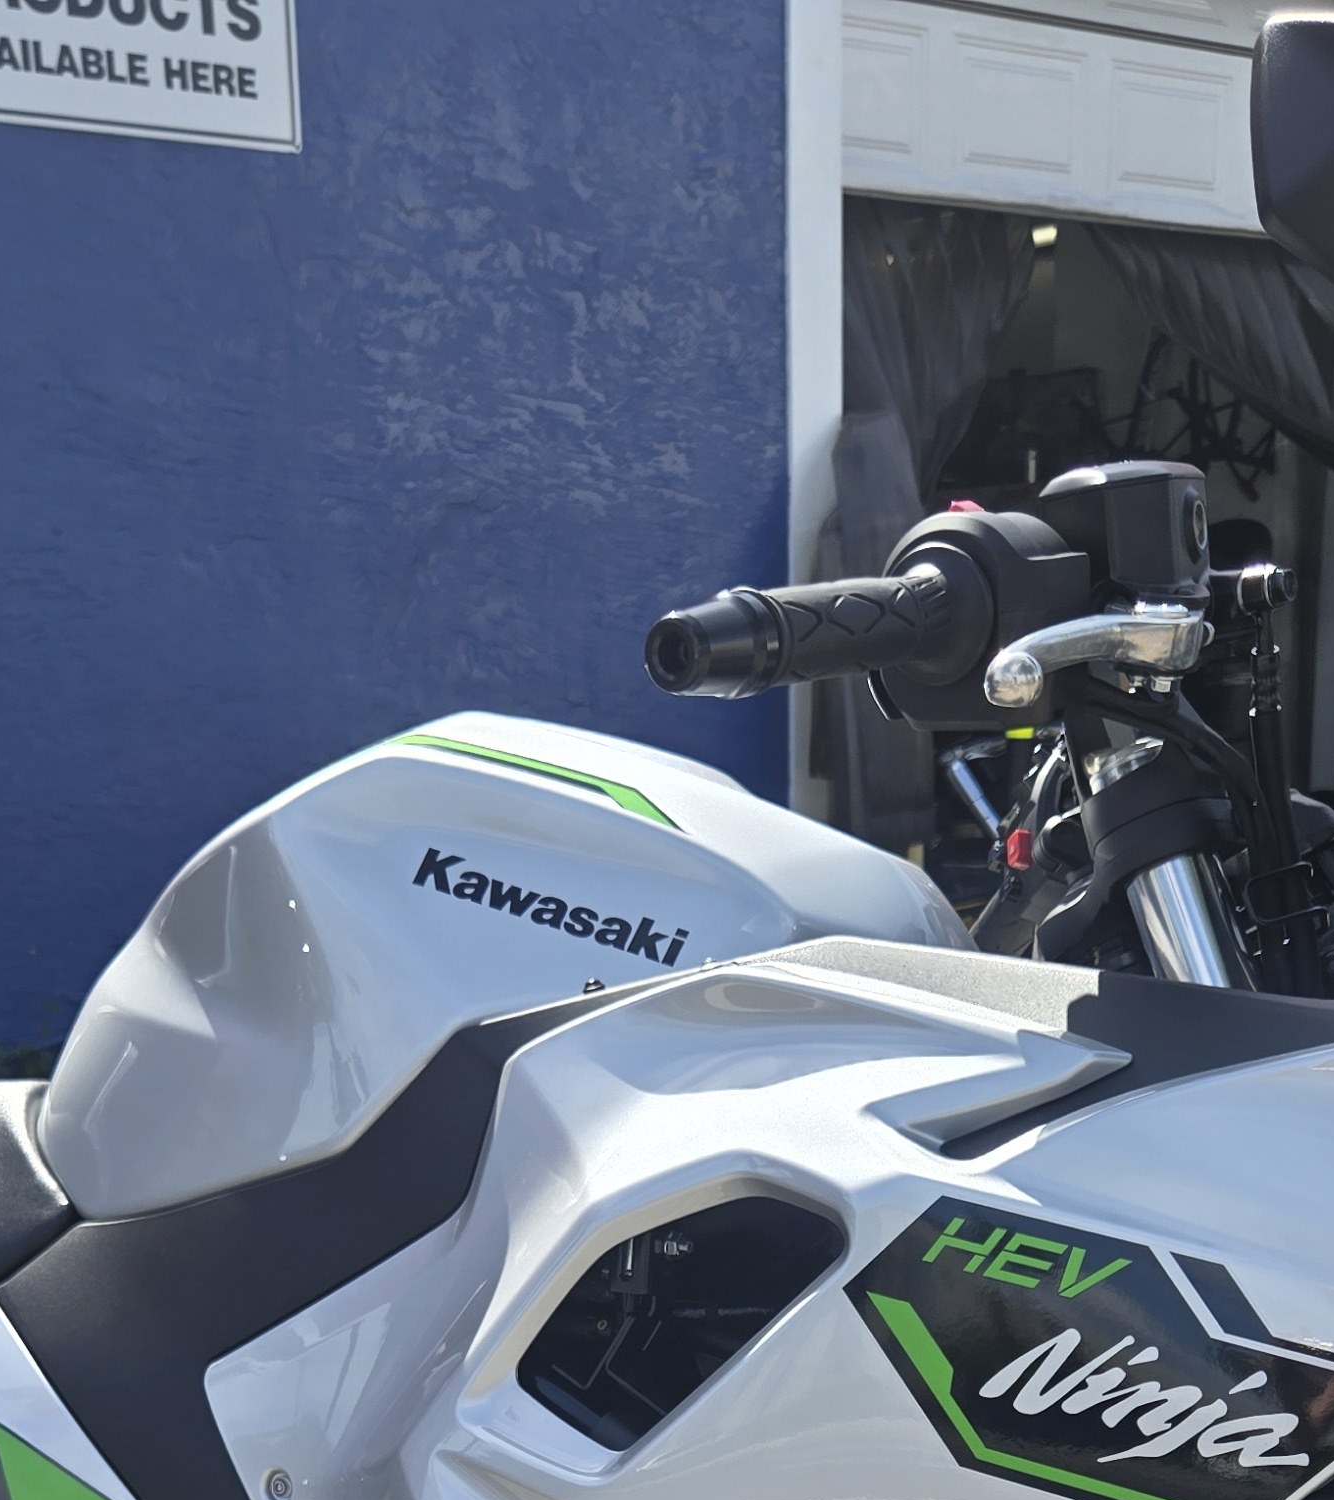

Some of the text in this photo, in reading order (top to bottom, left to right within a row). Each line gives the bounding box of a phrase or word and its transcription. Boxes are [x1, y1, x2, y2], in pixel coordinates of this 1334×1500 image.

[164, 57, 259, 100] HERE
[412, 847, 690, 968] Kawasaki
[922, 1217, 1133, 1298] HEV
[978, 1328, 1310, 1468] Ninja
